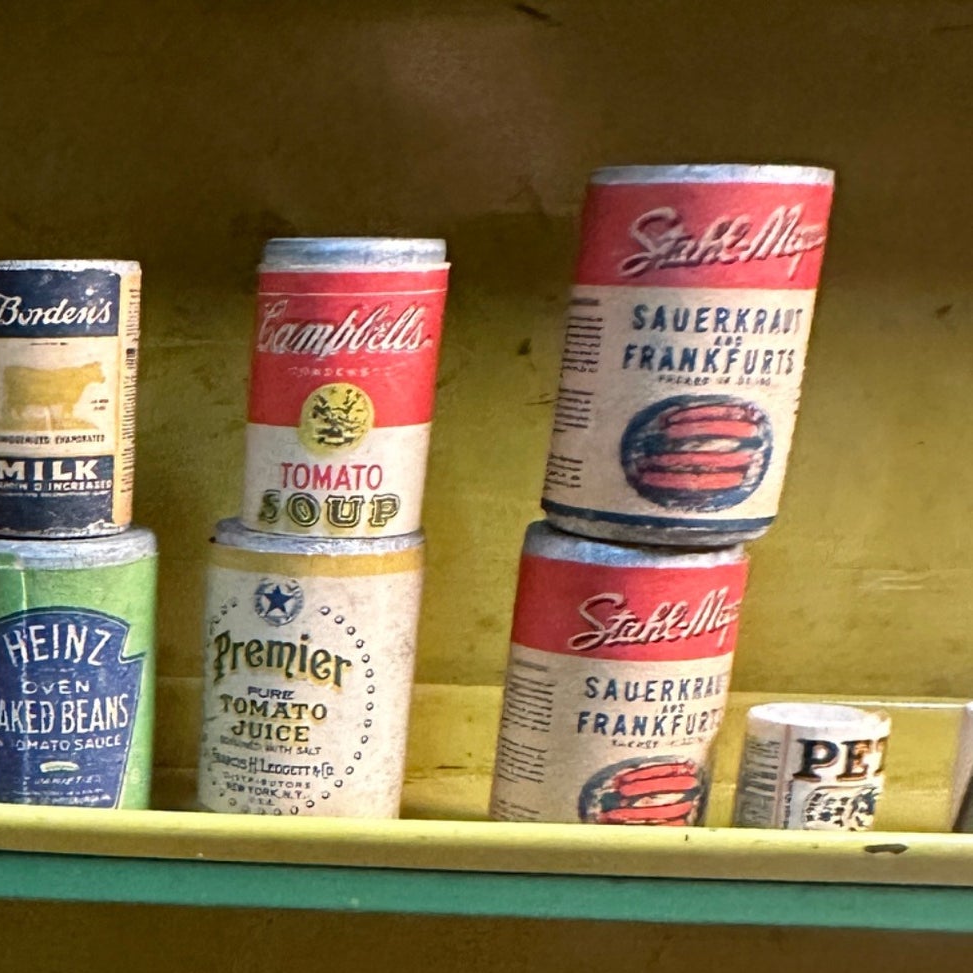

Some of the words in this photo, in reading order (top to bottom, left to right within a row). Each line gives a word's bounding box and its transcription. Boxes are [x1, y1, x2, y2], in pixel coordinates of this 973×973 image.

[632, 304, 803, 334] SAUERKRAUT
[622, 344, 795, 375] FRANKFURTS
[48, 480, 113, 491] INCREASED
[281, 462, 383, 490] TOMATO
[259, 490, 400, 528] SOUP
[2, 623, 112, 666] HEINZ
[213, 631, 353, 688] Premier
[22, 679, 90, 694] OVEN
[247, 686, 295, 700] PURE
[61, 693, 129, 734] BEANS
[220, 693, 328, 720] TOMATO
[12, 740, 71, 751] OMATO
[74, 734, 122, 750] SAUCE
[231, 720, 310, 742] JUICE
